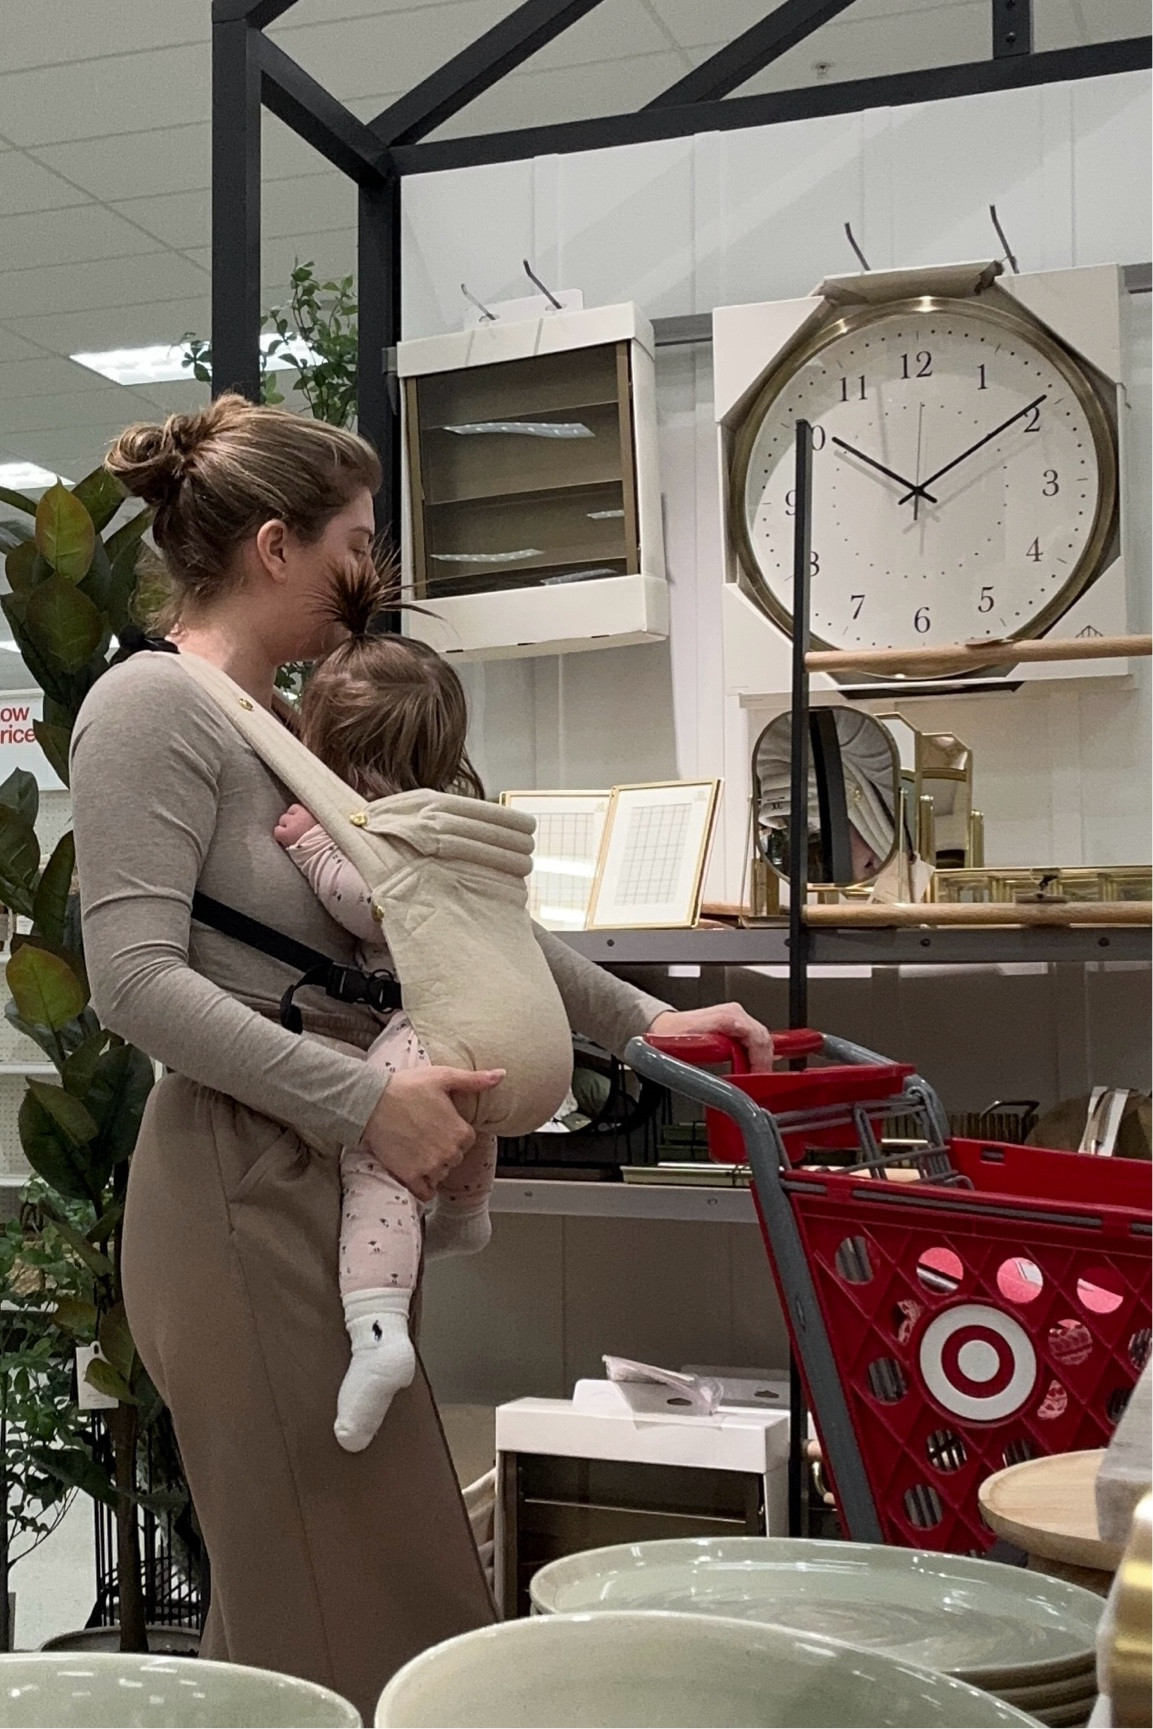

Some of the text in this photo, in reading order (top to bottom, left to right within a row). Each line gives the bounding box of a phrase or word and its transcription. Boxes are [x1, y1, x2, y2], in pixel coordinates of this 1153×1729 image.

[900, 350, 934, 380] 12
[976, 363, 988, 391] 1
[839, 374, 868, 403] 11
[1023, 407, 1042, 434] 2
[811, 424, 826, 451] 0
[1042, 469, 1060, 497] 3
[1025, 537, 1044, 563] 4
[850, 595, 866, 620] 7
[977, 586, 995, 613] 5
[913, 607, 931, 634] 6
[0, 706, 30, 722] ow
[0, 724, 36, 744] rice
